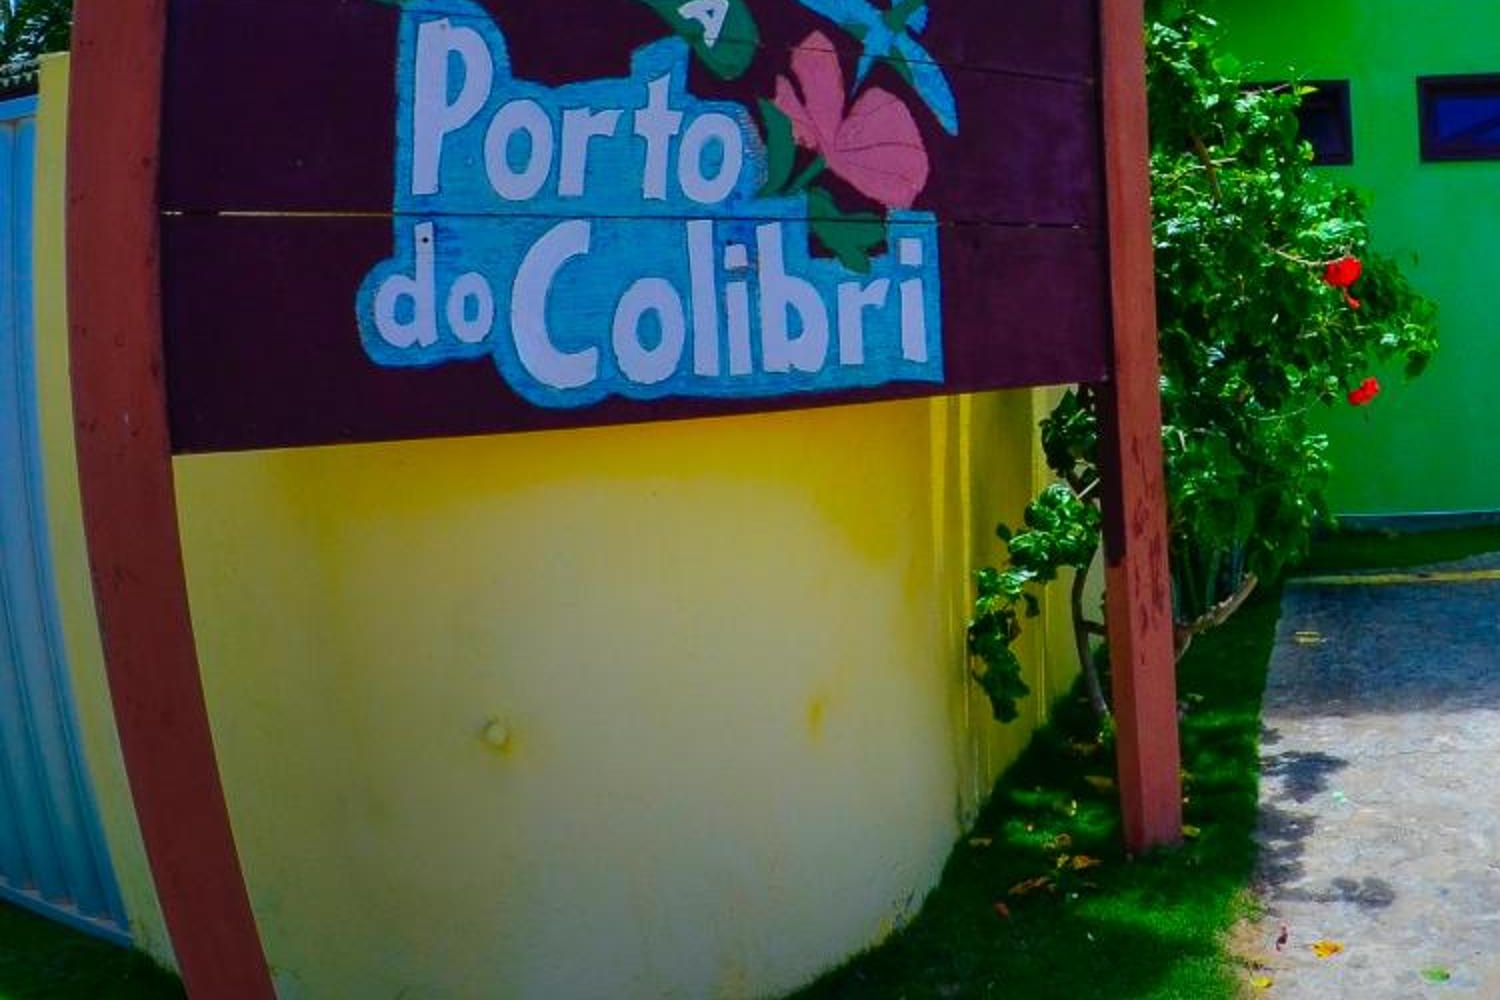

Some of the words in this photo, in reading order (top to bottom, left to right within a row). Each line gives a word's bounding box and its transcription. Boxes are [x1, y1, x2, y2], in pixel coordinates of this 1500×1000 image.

[411, 17, 743, 203] Porto
[373, 221, 495, 348] do
[511, 218, 928, 389] Colibri
